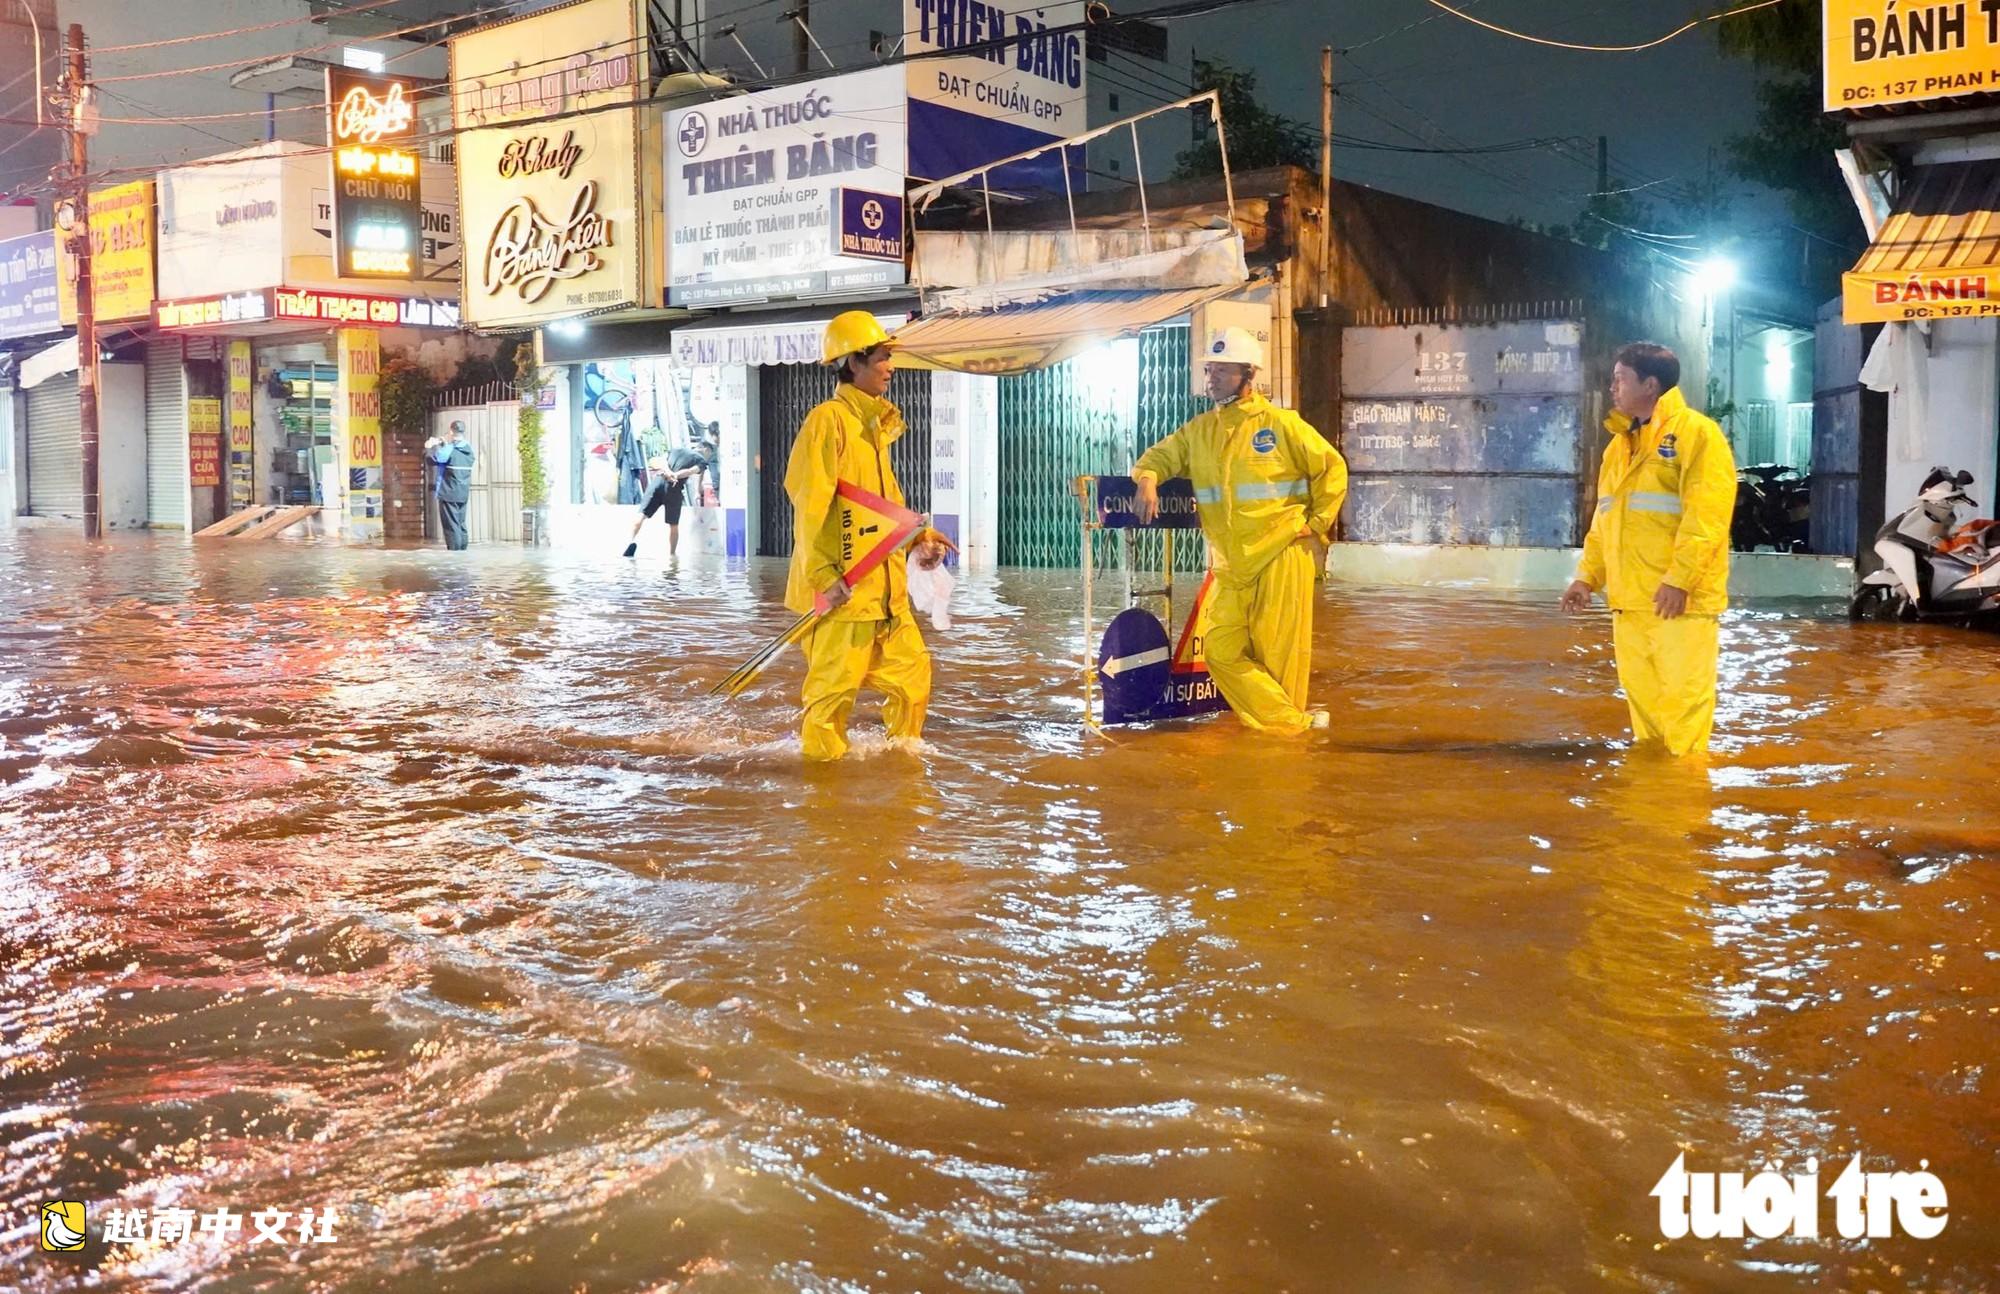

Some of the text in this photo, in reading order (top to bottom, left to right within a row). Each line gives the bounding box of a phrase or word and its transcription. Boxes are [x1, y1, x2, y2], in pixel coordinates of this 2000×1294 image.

[1853, 1, 1966, 62] BÁNH
[938, 72, 1062, 122] ĐẠT CHUẨN GPP
[1843, 87, 1875, 101] ĐC:
[1884, 80, 1918, 96] 137
[1925, 72, 1983, 91] PHAN
[718, 88, 833, 138] NHÀ THUỐC
[682, 144, 776, 196] THIÊN
[344, 177, 379, 197] CHỮ
[733, 186, 818, 213] ĐẠT CHUẨN GPP
[716, 214, 752, 239] THUỐC
[843, 232, 860, 250] NHÀ
[860, 232, 885, 254] THUỐC
[1875, 276, 1987, 304] BÁNH
[370, 299, 398, 323] CAO
[1904, 307, 1934, 318] ĐC:
[1941, 305, 1973, 316] 137
[1419, 351, 1469, 372] 137
[1353, 402, 1446, 426] GIAO NHẬN HÀNG
[232, 425, 250, 446] CAO
[352, 434, 377, 461] CAO
[1103, 492, 1134, 514] CÔN
[842, 509, 853, 561] HỐ SÂU
[1177, 681, 1194, 707] SỰ
[1196, 676, 1217, 700] BẤT
